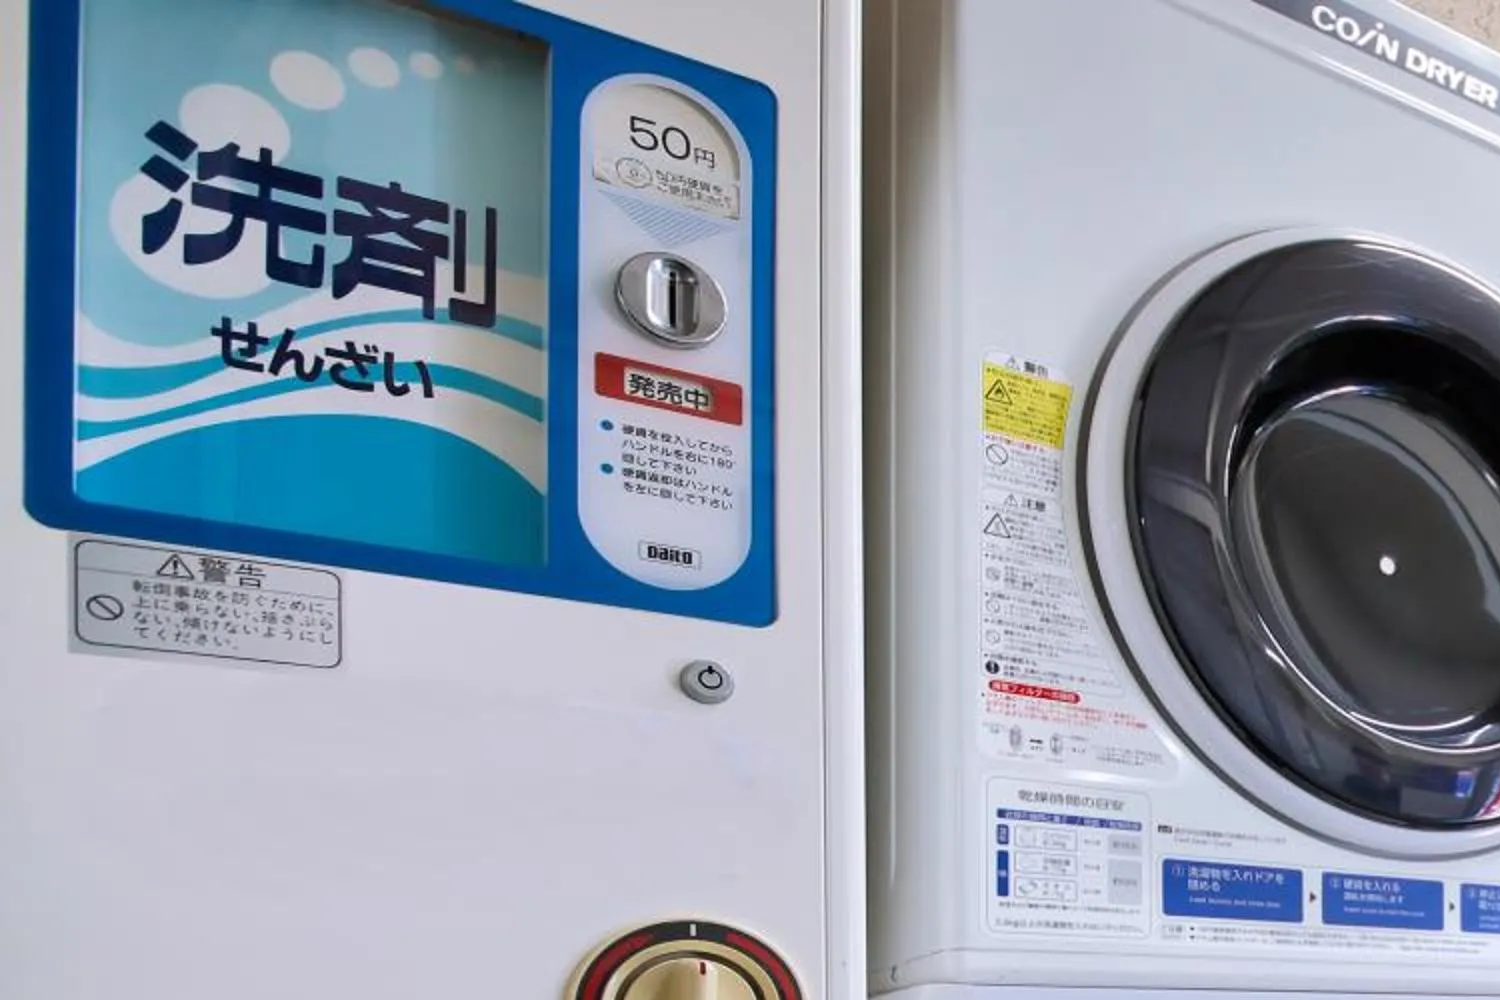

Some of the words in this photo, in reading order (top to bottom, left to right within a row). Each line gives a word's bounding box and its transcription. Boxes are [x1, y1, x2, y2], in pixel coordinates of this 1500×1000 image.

[1405, 47, 1499, 109] DRYER
[630, 116, 715, 169] 50円
[140, 119, 499, 328] 洗剤
[210, 317, 436, 400] せんざい
[628, 372, 710, 411] 発売中
[199, 557, 267, 588] 警告
[647, 544, 693, 565] Daito
